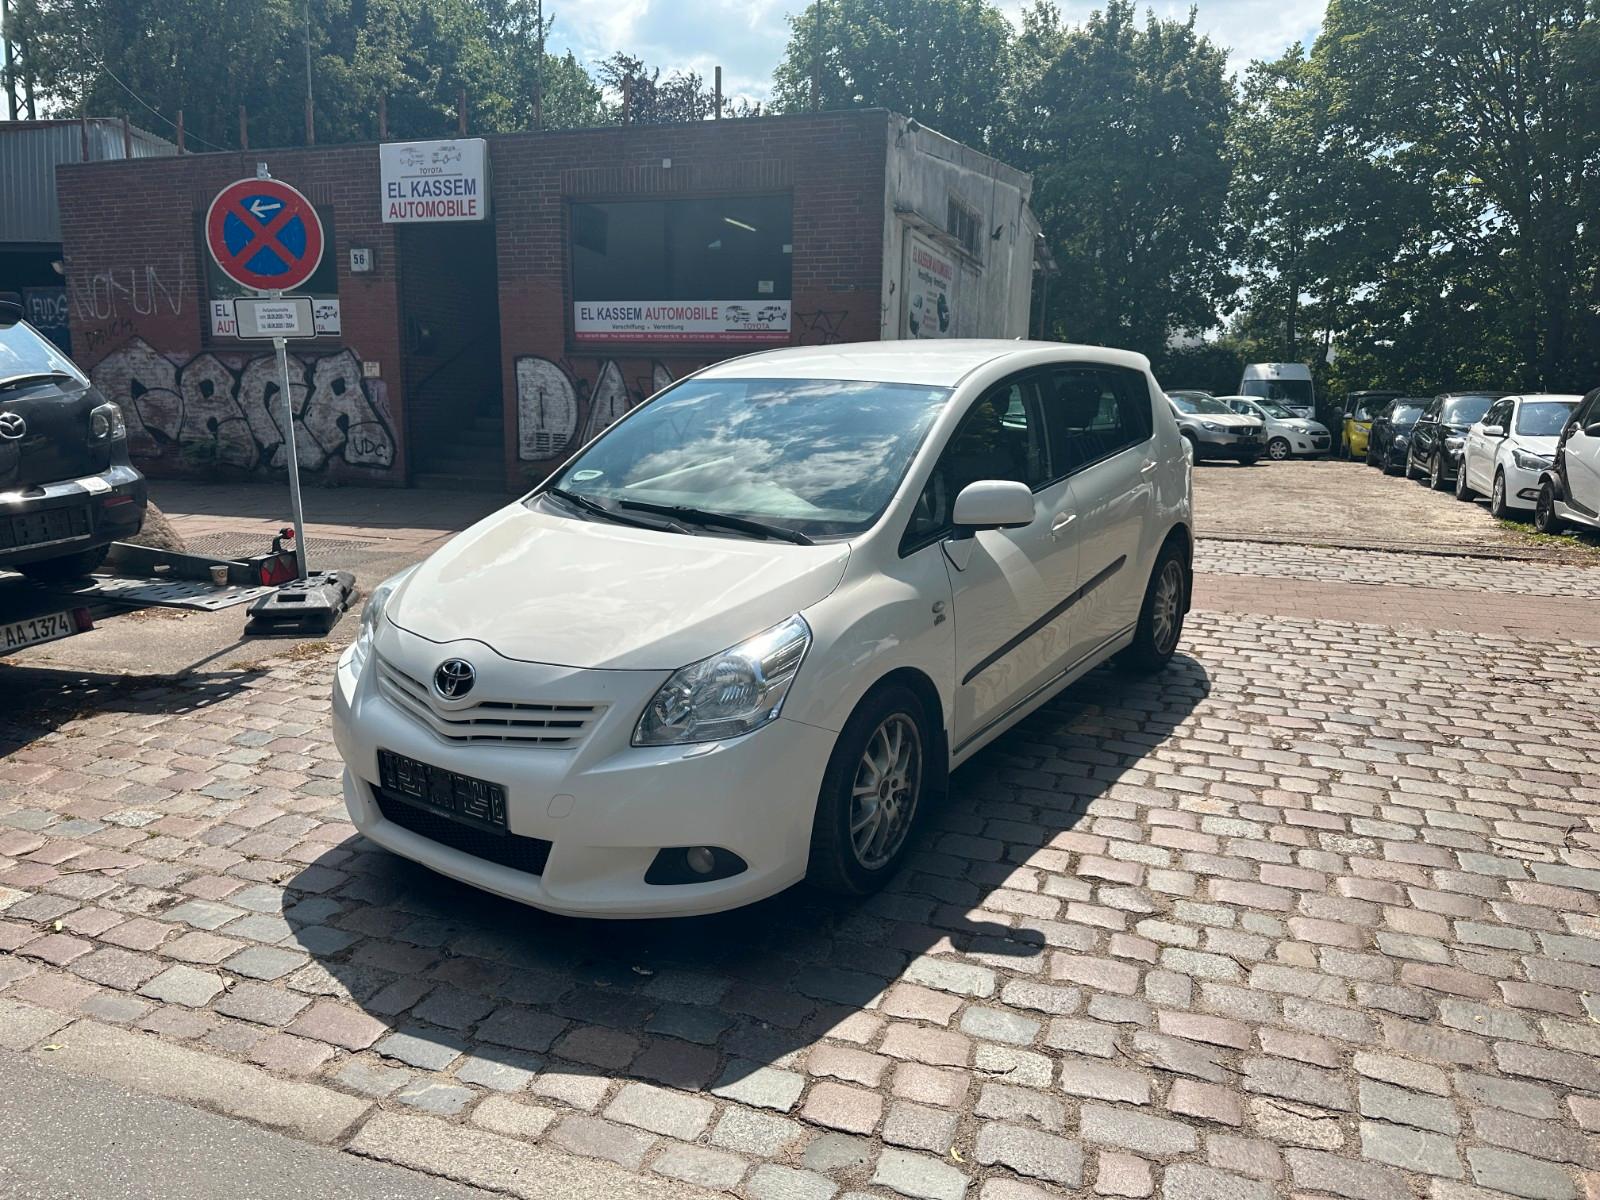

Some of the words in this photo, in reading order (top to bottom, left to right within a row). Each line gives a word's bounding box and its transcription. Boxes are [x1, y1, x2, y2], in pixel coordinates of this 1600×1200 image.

[419, 167, 443, 175] TOYOTA
[387, 182, 407, 199] EL
[410, 178, 477, 198] KASSEM
[388, 199, 477, 219] AUTOMOBILE
[353, 253, 366, 265] 56
[215, 304, 230, 317] EL
[580, 307, 595, 322] EL
[596, 307, 643, 322] KASSEM
[644, 306, 719, 322] AUTOMOBILE
[742, 322, 771, 330] TOYOTA
[5, 624, 28, 648] AA
[28, 614, 70, 641] 1374
